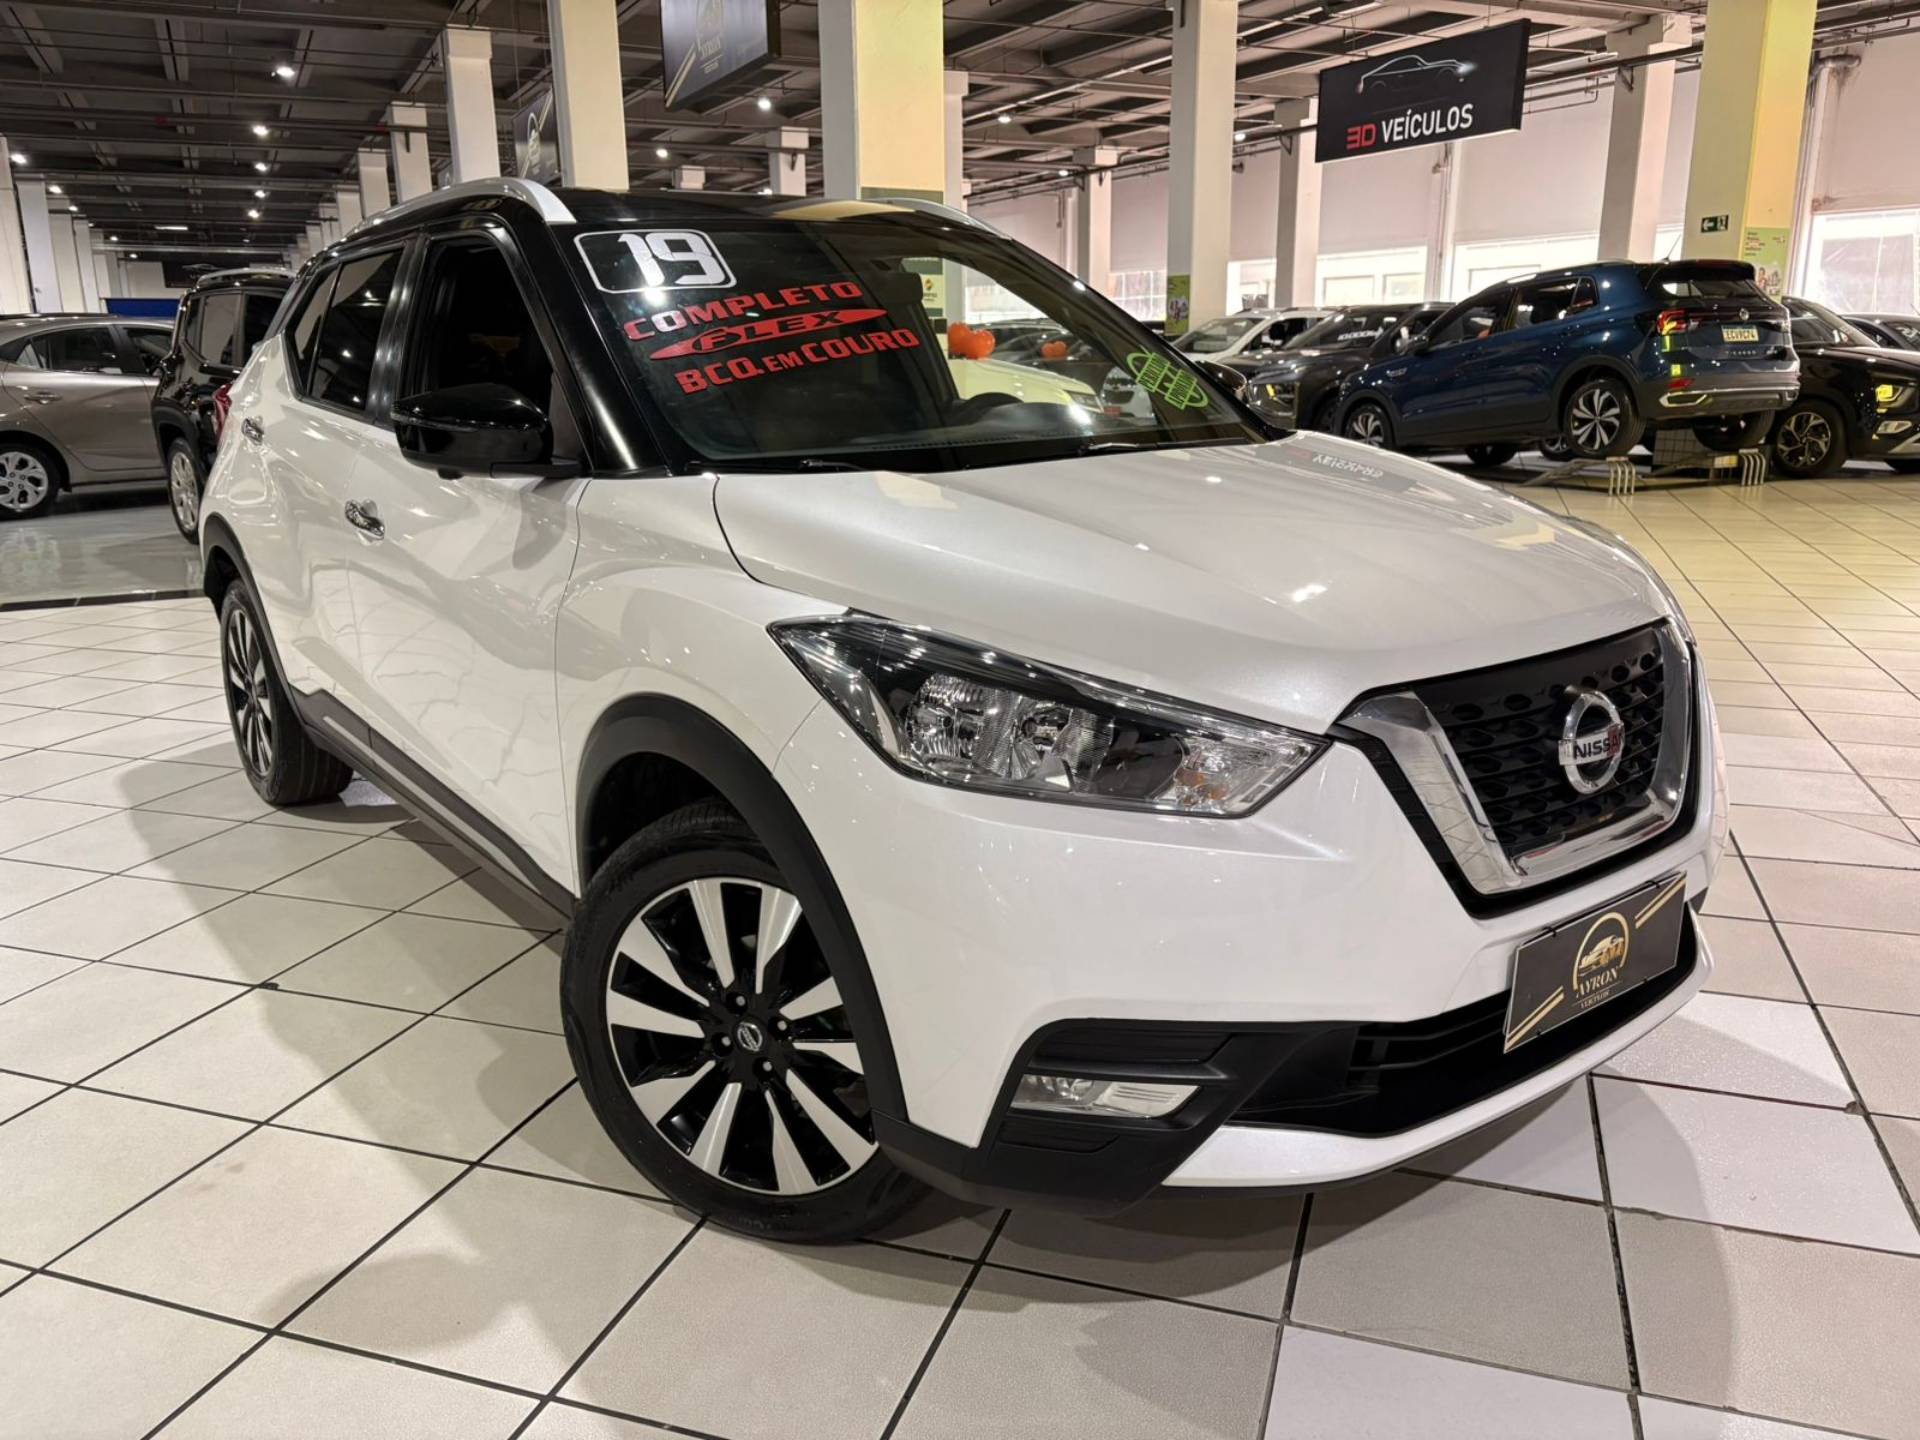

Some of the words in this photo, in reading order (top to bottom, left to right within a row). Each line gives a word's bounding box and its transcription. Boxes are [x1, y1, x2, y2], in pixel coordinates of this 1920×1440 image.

[1346, 123, 1377, 149] 3D
[1381, 103, 1474, 143] VEÍCULOS
[618, 232, 726, 287] 19
[623, 281, 863, 341] COMPLETO
[699, 311, 841, 351] FLEX
[762, 351, 804, 372] EM
[801, 328, 920, 363] COURO
